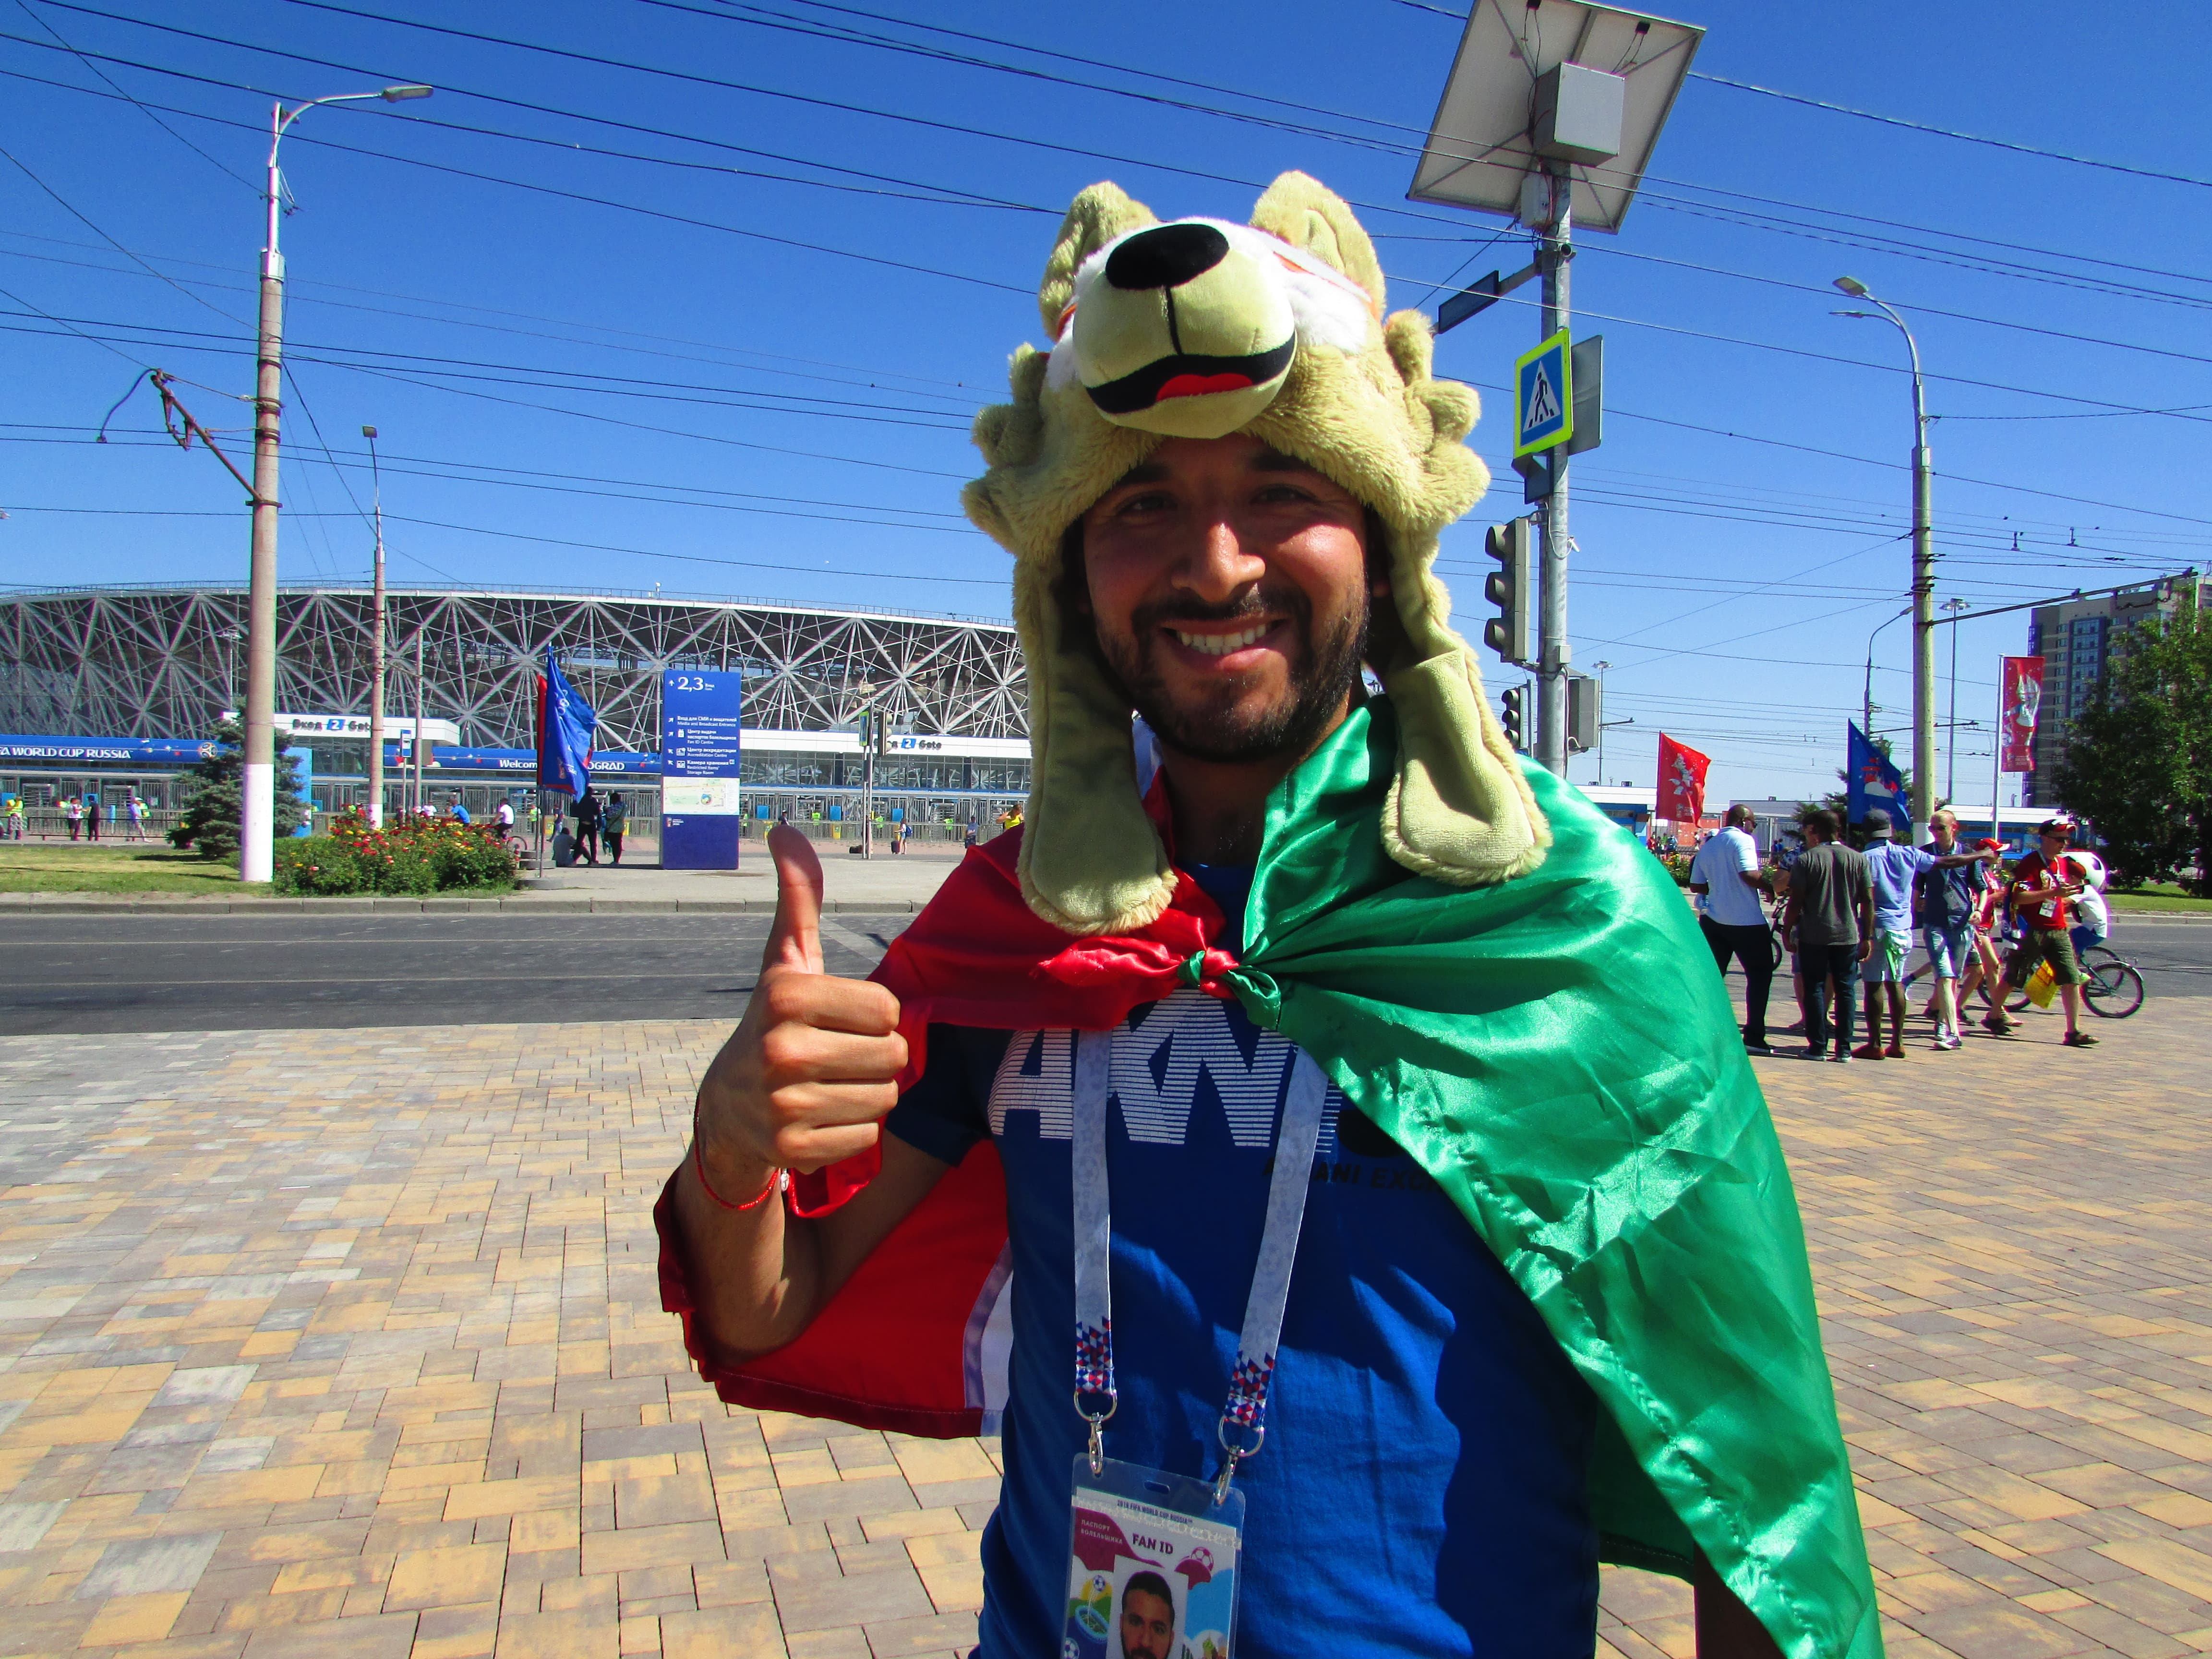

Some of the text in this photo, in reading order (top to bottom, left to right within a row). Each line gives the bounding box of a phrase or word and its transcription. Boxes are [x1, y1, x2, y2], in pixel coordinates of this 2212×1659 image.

[677, 677, 704, 692] 2,3
[332, 720, 340, 730] 2
[349, 721, 371, 732] Gat
[905, 739, 912, 748] 2
[919, 740, 942, 750] Gate
[13, 747, 57, 757] WORLD
[59, 748, 85, 757] CUP
[499, 759, 537, 768] Welcom
[1130, 1503, 1141, 1511] FIFA
[1142, 1505, 1158, 1516] WORLD
[1081, 1519, 1110, 1531] ПАСПОРТ
[1132, 1532, 1174, 1554] FAN ID
